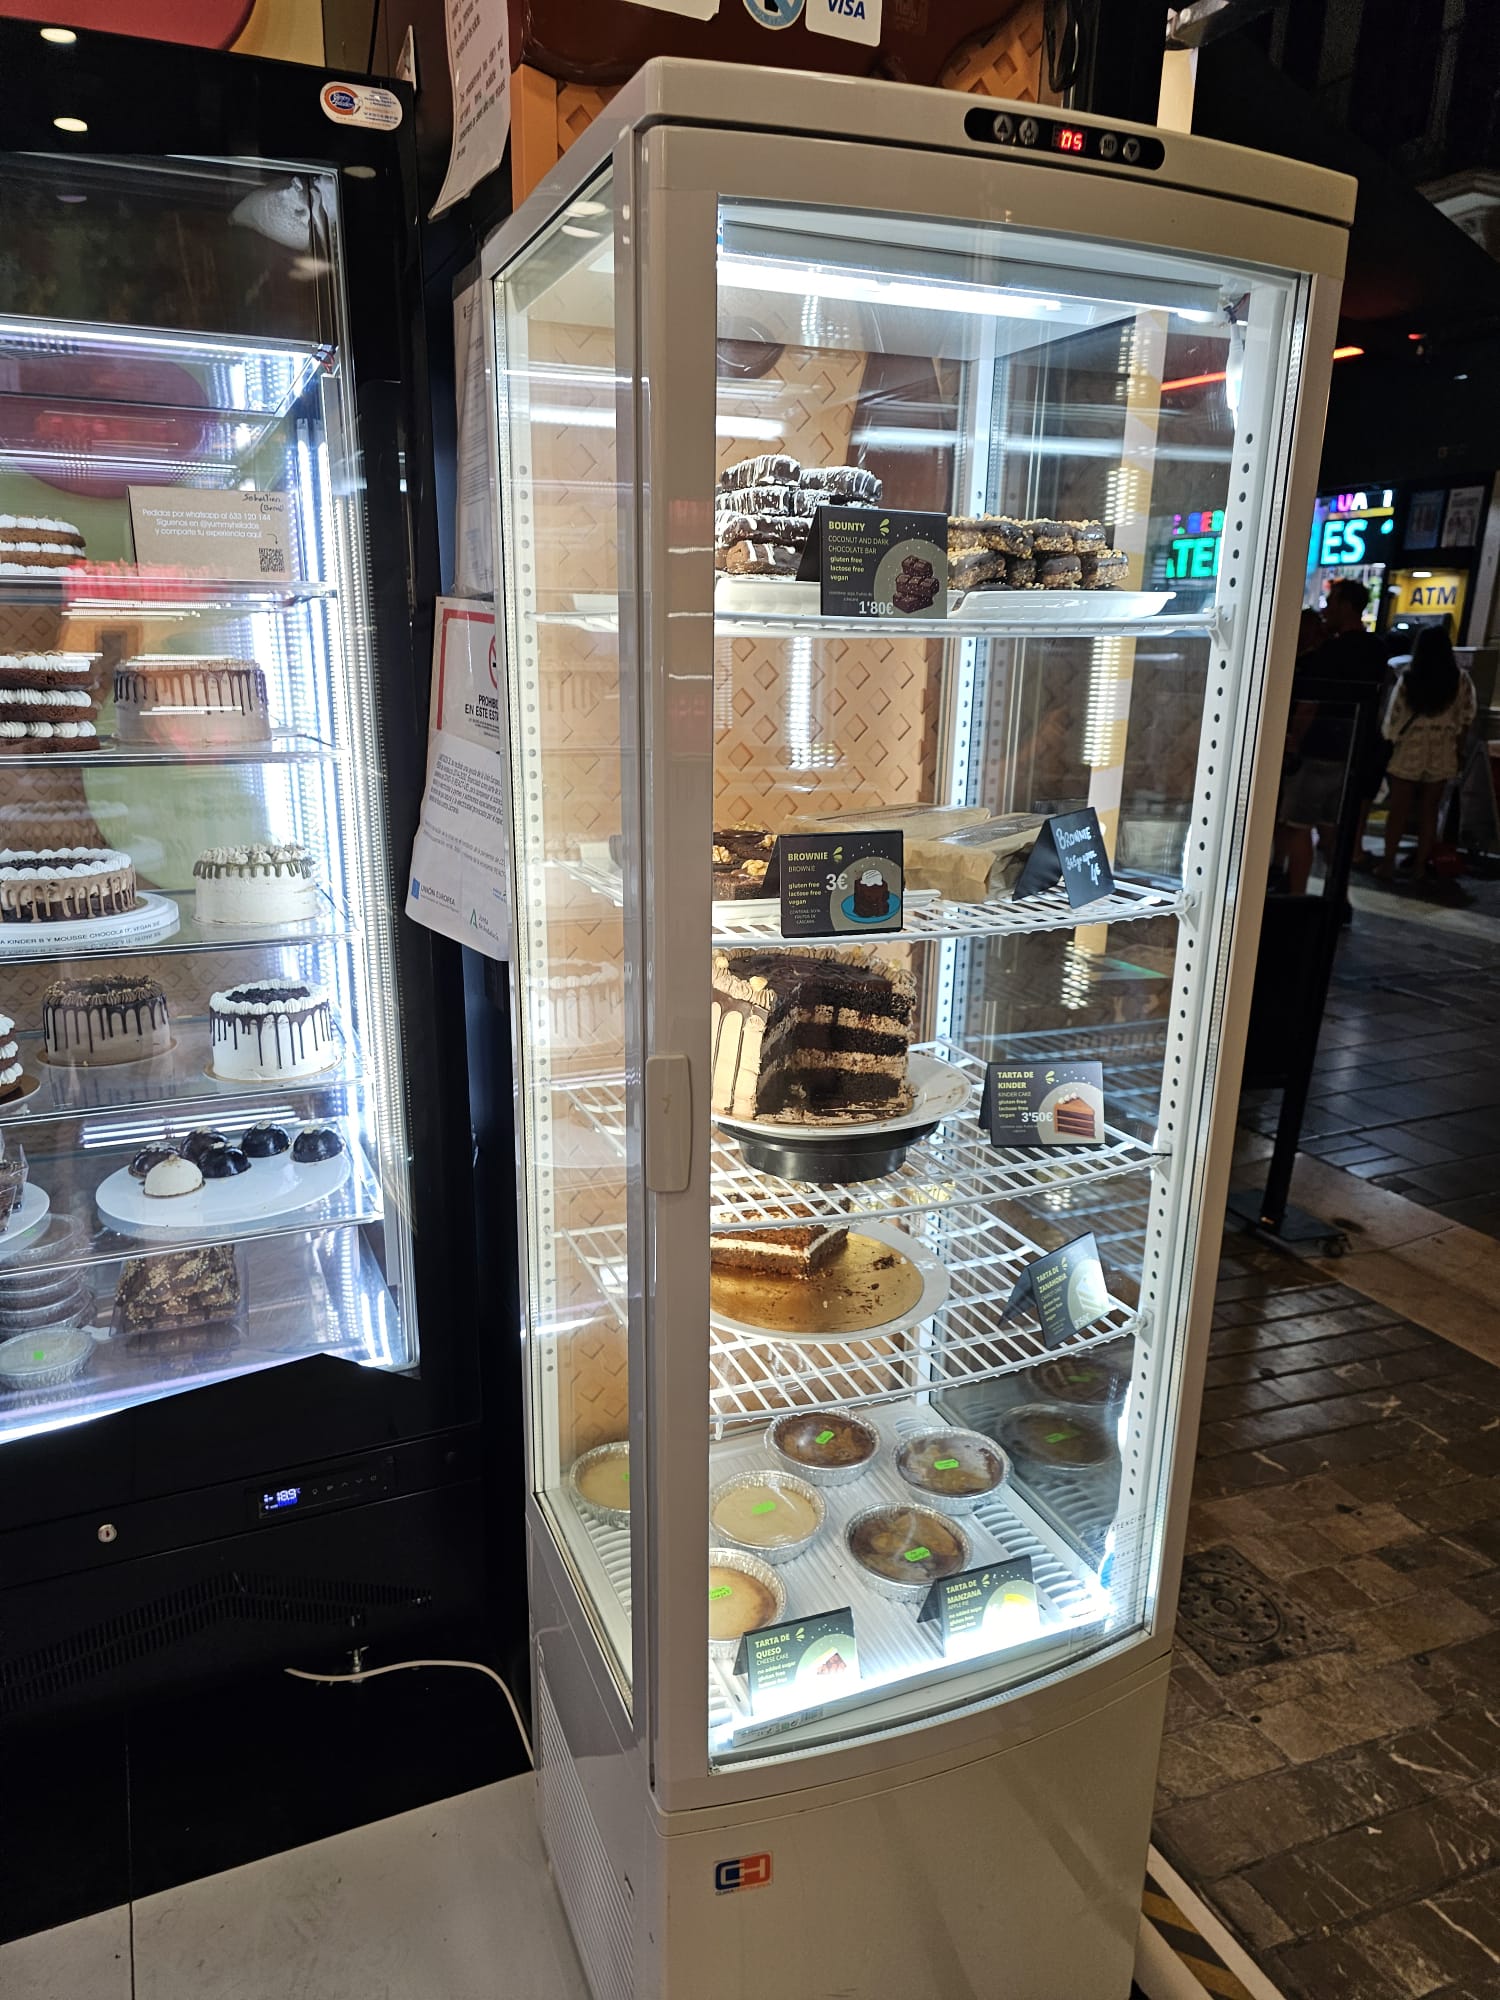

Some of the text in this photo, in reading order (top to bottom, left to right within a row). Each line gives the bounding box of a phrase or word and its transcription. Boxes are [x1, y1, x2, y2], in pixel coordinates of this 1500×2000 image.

[828, 0, 865, 20] VISA
[143, 508, 171, 517] Pedidos
[172, 511, 184, 519] por
[186, 512, 220, 520] whatsapp
[200, 520, 260, 530] @yummyhelados
[828, 521, 865, 532] BOUNTY
[161, 528, 196, 536] comparte
[206, 530, 245, 538] experiencia
[828, 535, 889, 546] COCONUT AND DARK
[828, 546, 877, 555] CHOCOLATE BAR
[830, 556, 849, 564] gluten
[1409, 586, 1457, 606] ATM
[858, 601, 894, 614] 1'80€
[465, 703, 474, 715] EN
[475, 705, 489, 719] ESTE
[787, 851, 829, 862] BROWNIE
[788, 865, 816, 873] BROWNIE
[788, 882, 808, 890] gluten
[825, 873, 848, 891] 3€
[420, 884, 436, 897] UNIÓN
[436, 890, 455, 905] EUROPEA
[54, 934, 87, 943] MOUSSE
[997, 1071, 1034, 1079] TARTA DE
[1021, 1111, 1053, 1122] 3'50€
[1036, 1265, 1060, 1283] TARTA DE
[1039, 1273, 1067, 1294] ZANAHORIA
[946, 1579, 977, 1594] TARTA DE
[947, 1588, 982, 1605] MANZANA
[948, 1602, 962, 1610] APPLE
[955, 1609, 970, 1617] added
[970, 1605, 983, 1615] sugar
[949, 1618, 965, 1627] gluten
[754, 1632, 791, 1649] TARTA DE
[756, 1646, 782, 1660] QUESO
[756, 1652, 789, 1666] CHEESE CAKE
[765, 1664, 781, 1673] added
[781, 1661, 797, 1670] sugar
[758, 1670, 786, 1683] gluten free
